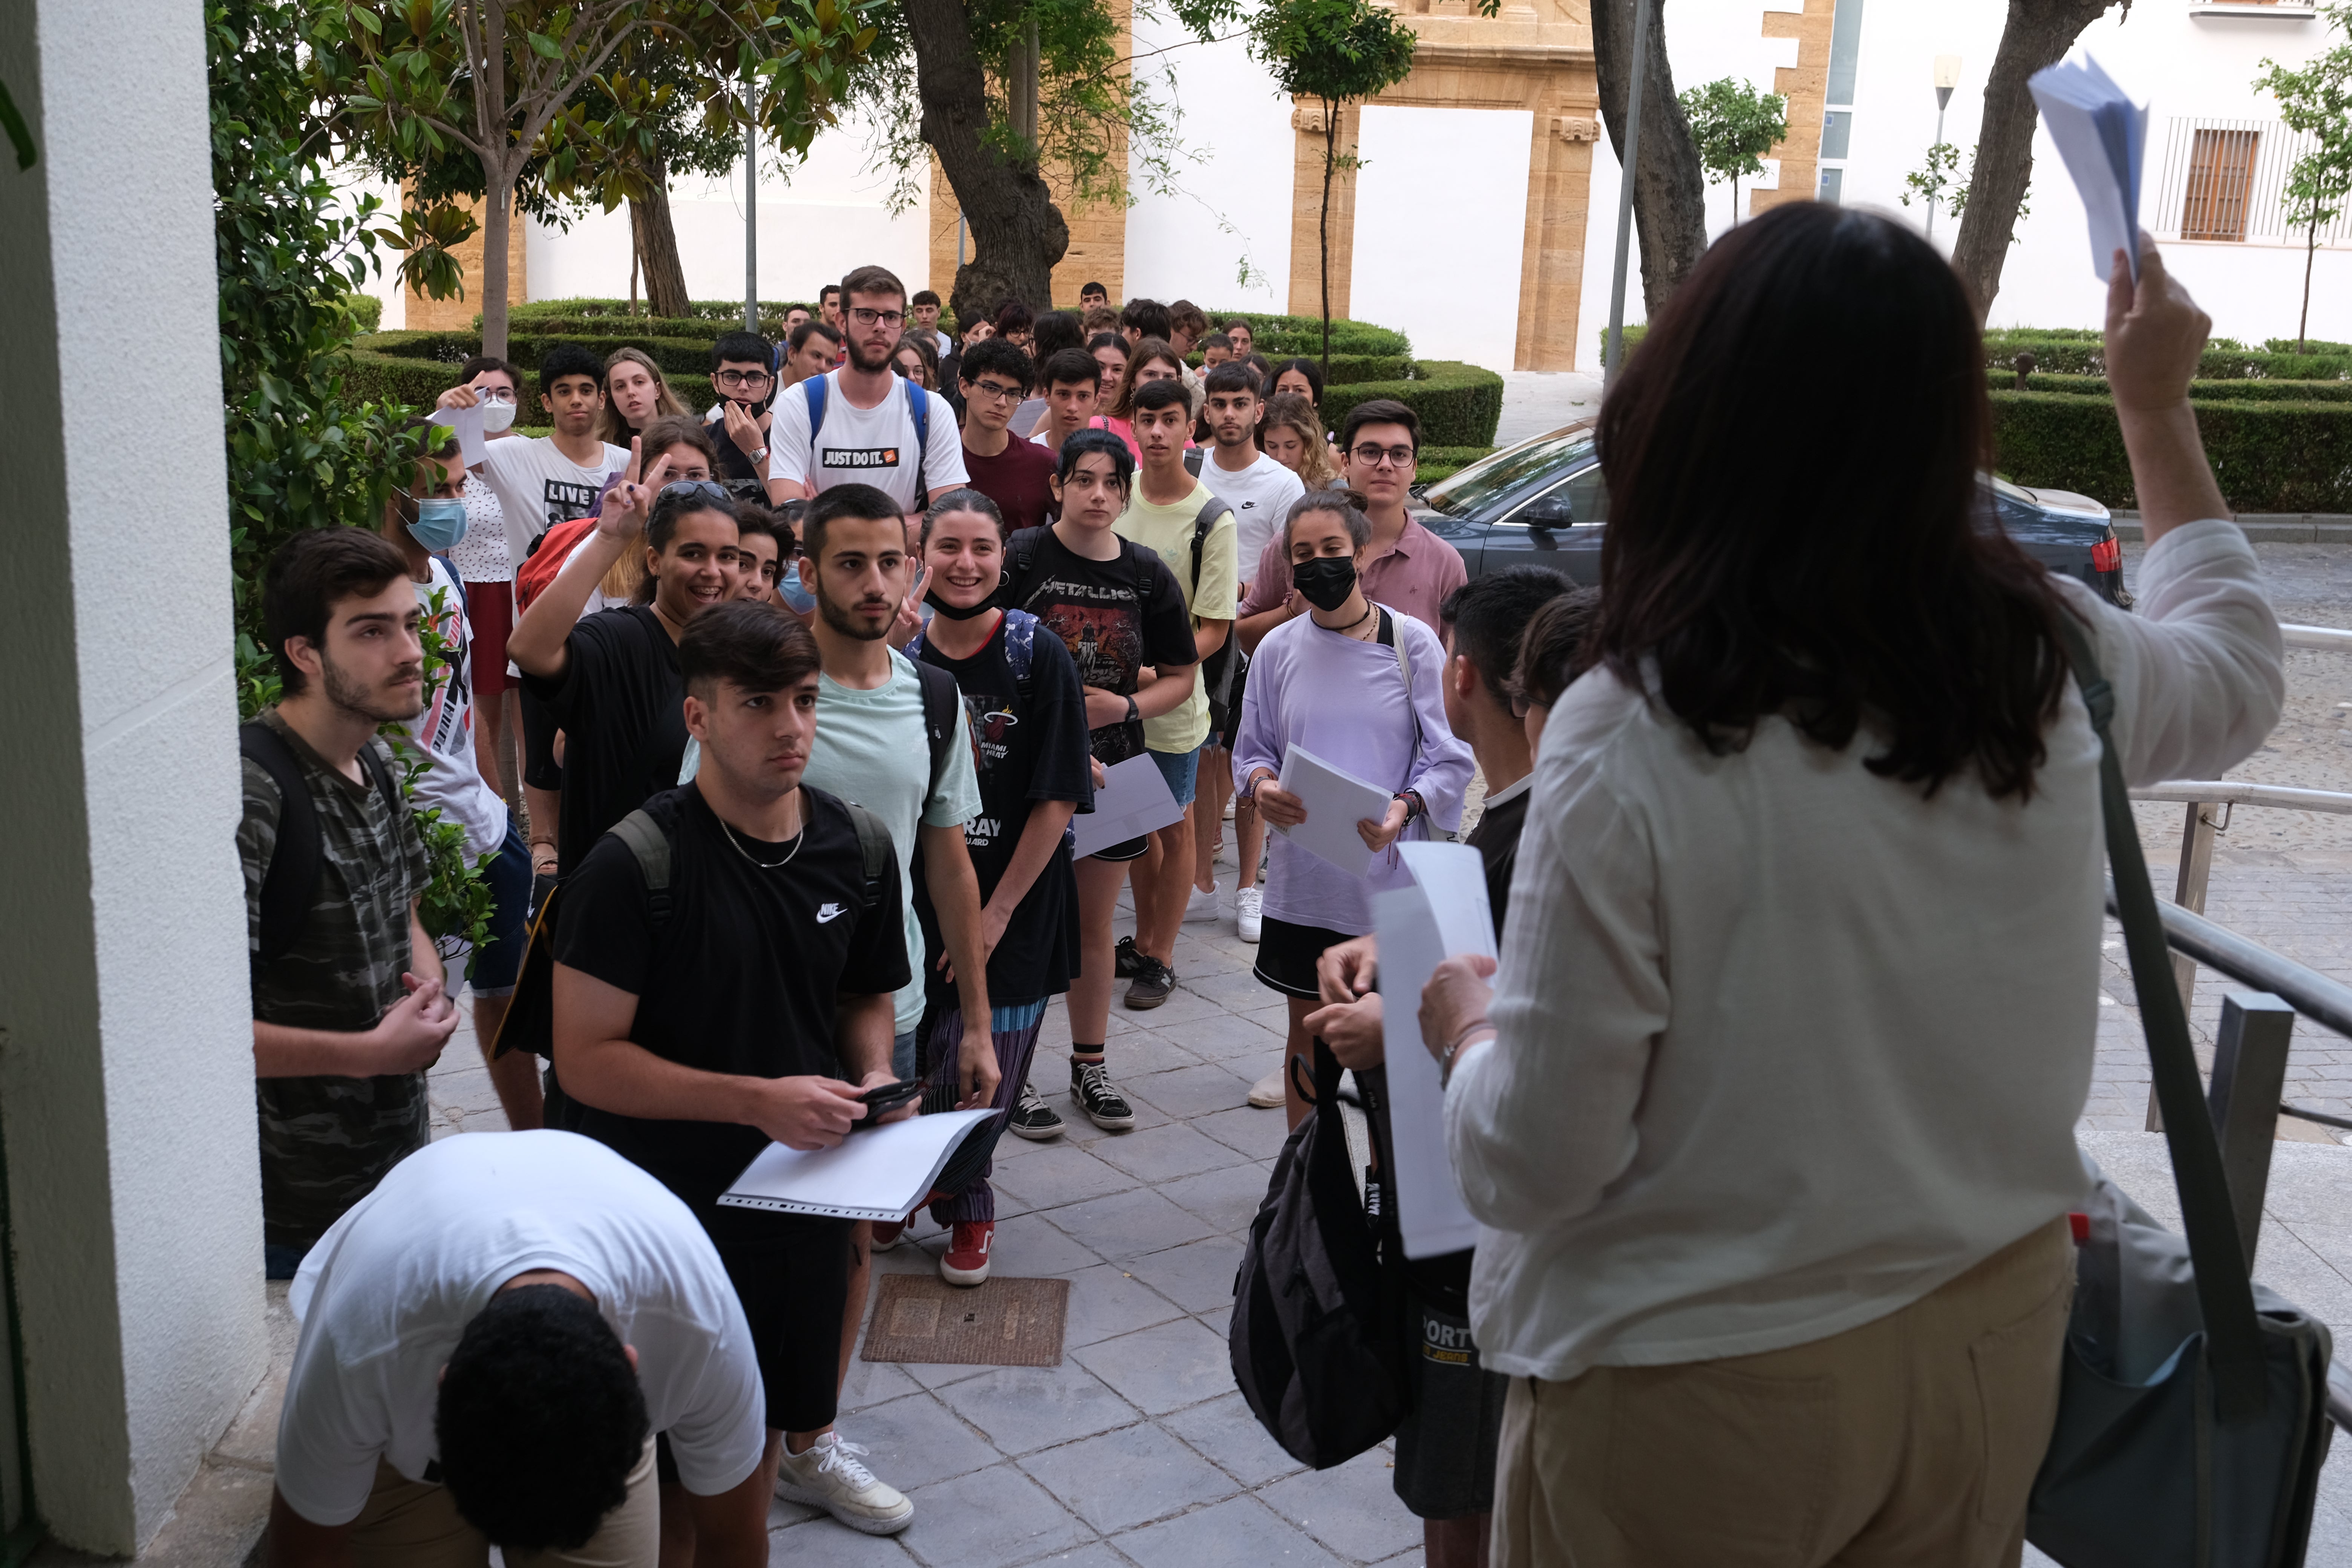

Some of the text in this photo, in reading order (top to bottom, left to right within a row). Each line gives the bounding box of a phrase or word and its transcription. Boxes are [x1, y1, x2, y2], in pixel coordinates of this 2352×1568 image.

[824, 451, 852, 465] JUST
[852, 452, 869, 466] DO
[869, 451, 884, 465] IT.
[548, 484, 589, 505] LIVE
[432, 701, 456, 755] PUMA
[981, 742, 1007, 752] MIAMI
[986, 749, 1009, 759] HEAT
[965, 837, 989, 846] UARD
[821, 903, 839, 915] NIKE
[1423, 1315, 1471, 1348] ORT
